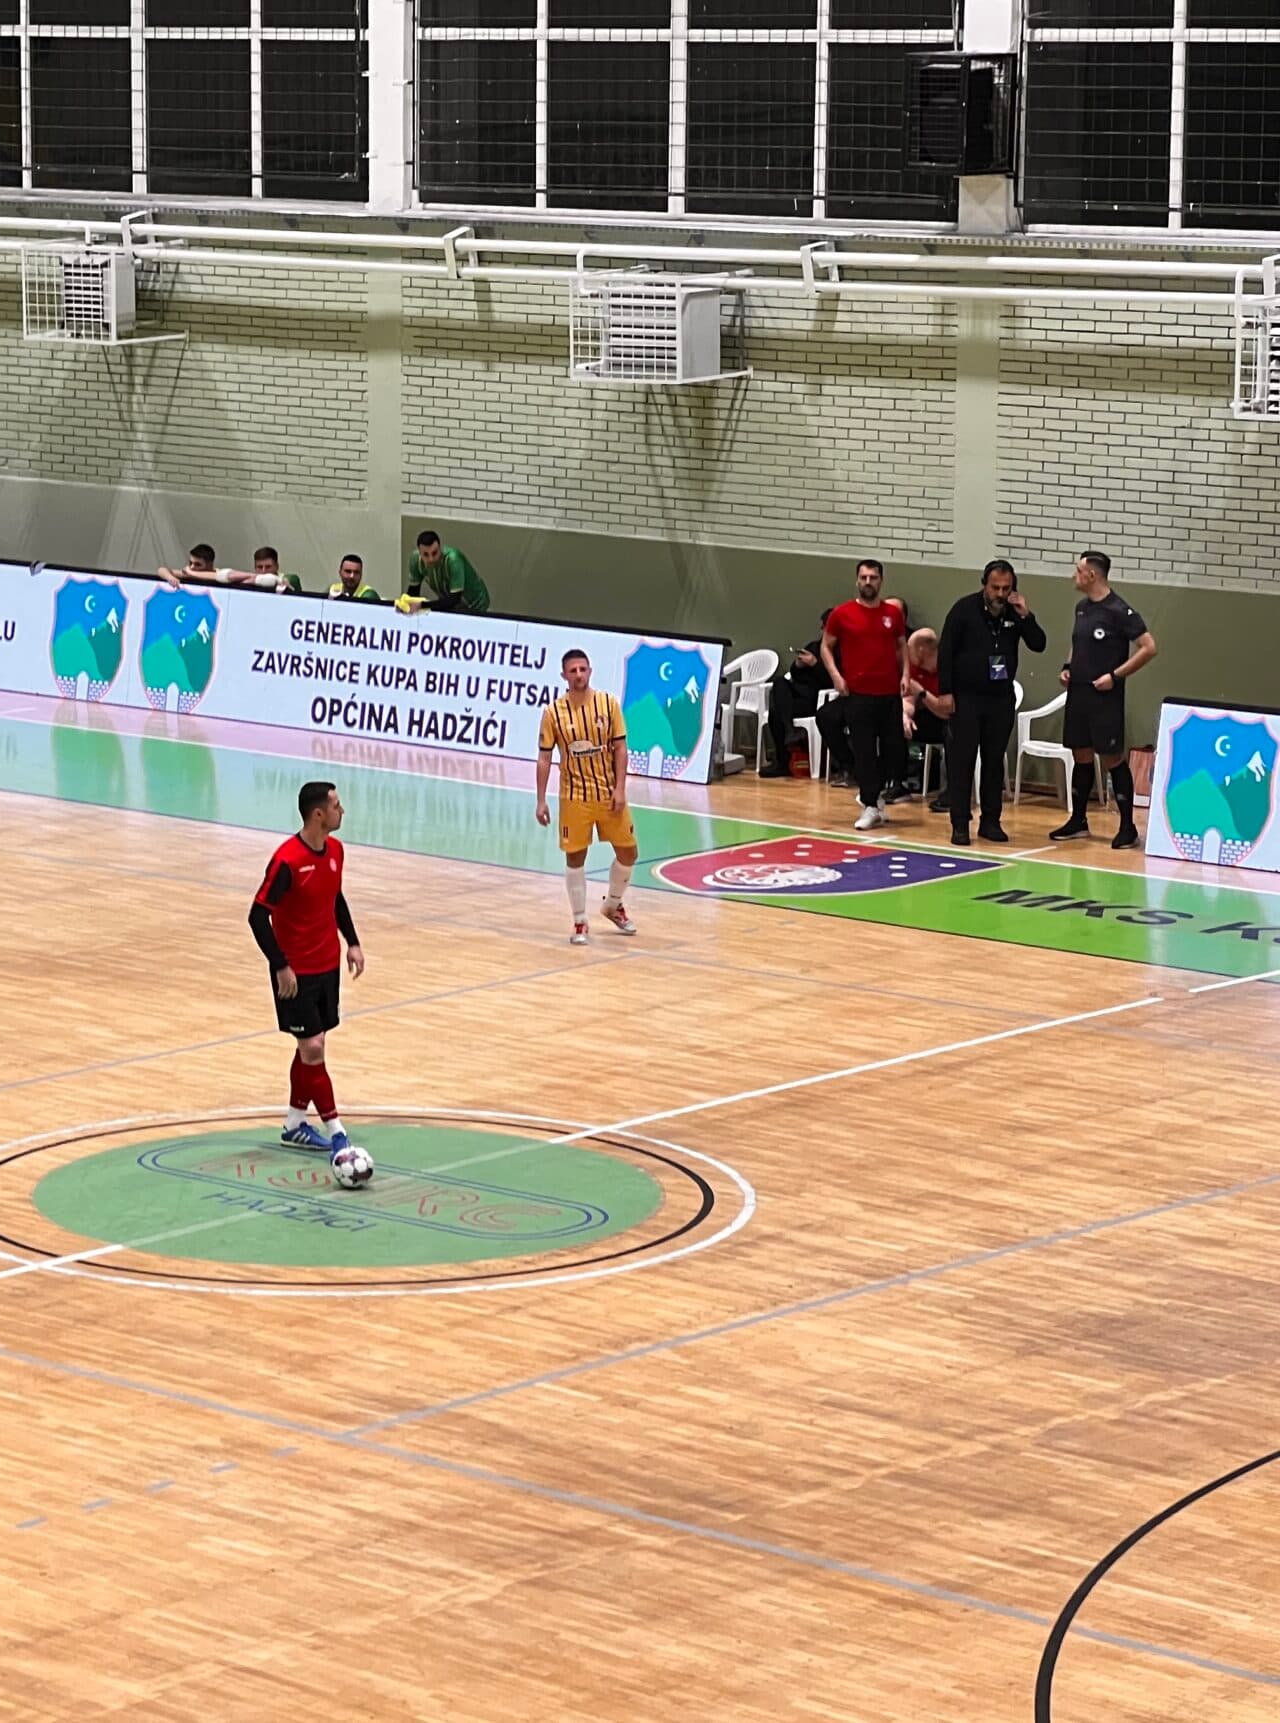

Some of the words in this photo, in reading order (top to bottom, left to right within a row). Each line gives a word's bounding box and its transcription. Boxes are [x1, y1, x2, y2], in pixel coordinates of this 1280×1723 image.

[290, 619, 401, 653] GENERALNI
[406, 631, 547, 670] POKROVITELJ
[251, 649, 361, 685] ZAVRŠNICE
[366, 663, 418, 692] KUPA
[424, 670, 460, 697] BIH
[466, 675, 481, 699] U
[485, 678, 570, 708] FUTSA
[311, 692, 399, 735] OPĆINA
[407, 706, 507, 749] HADŽIĆI
[972, 889, 1195, 925] MKS
[1199, 920, 1280, 945] K
